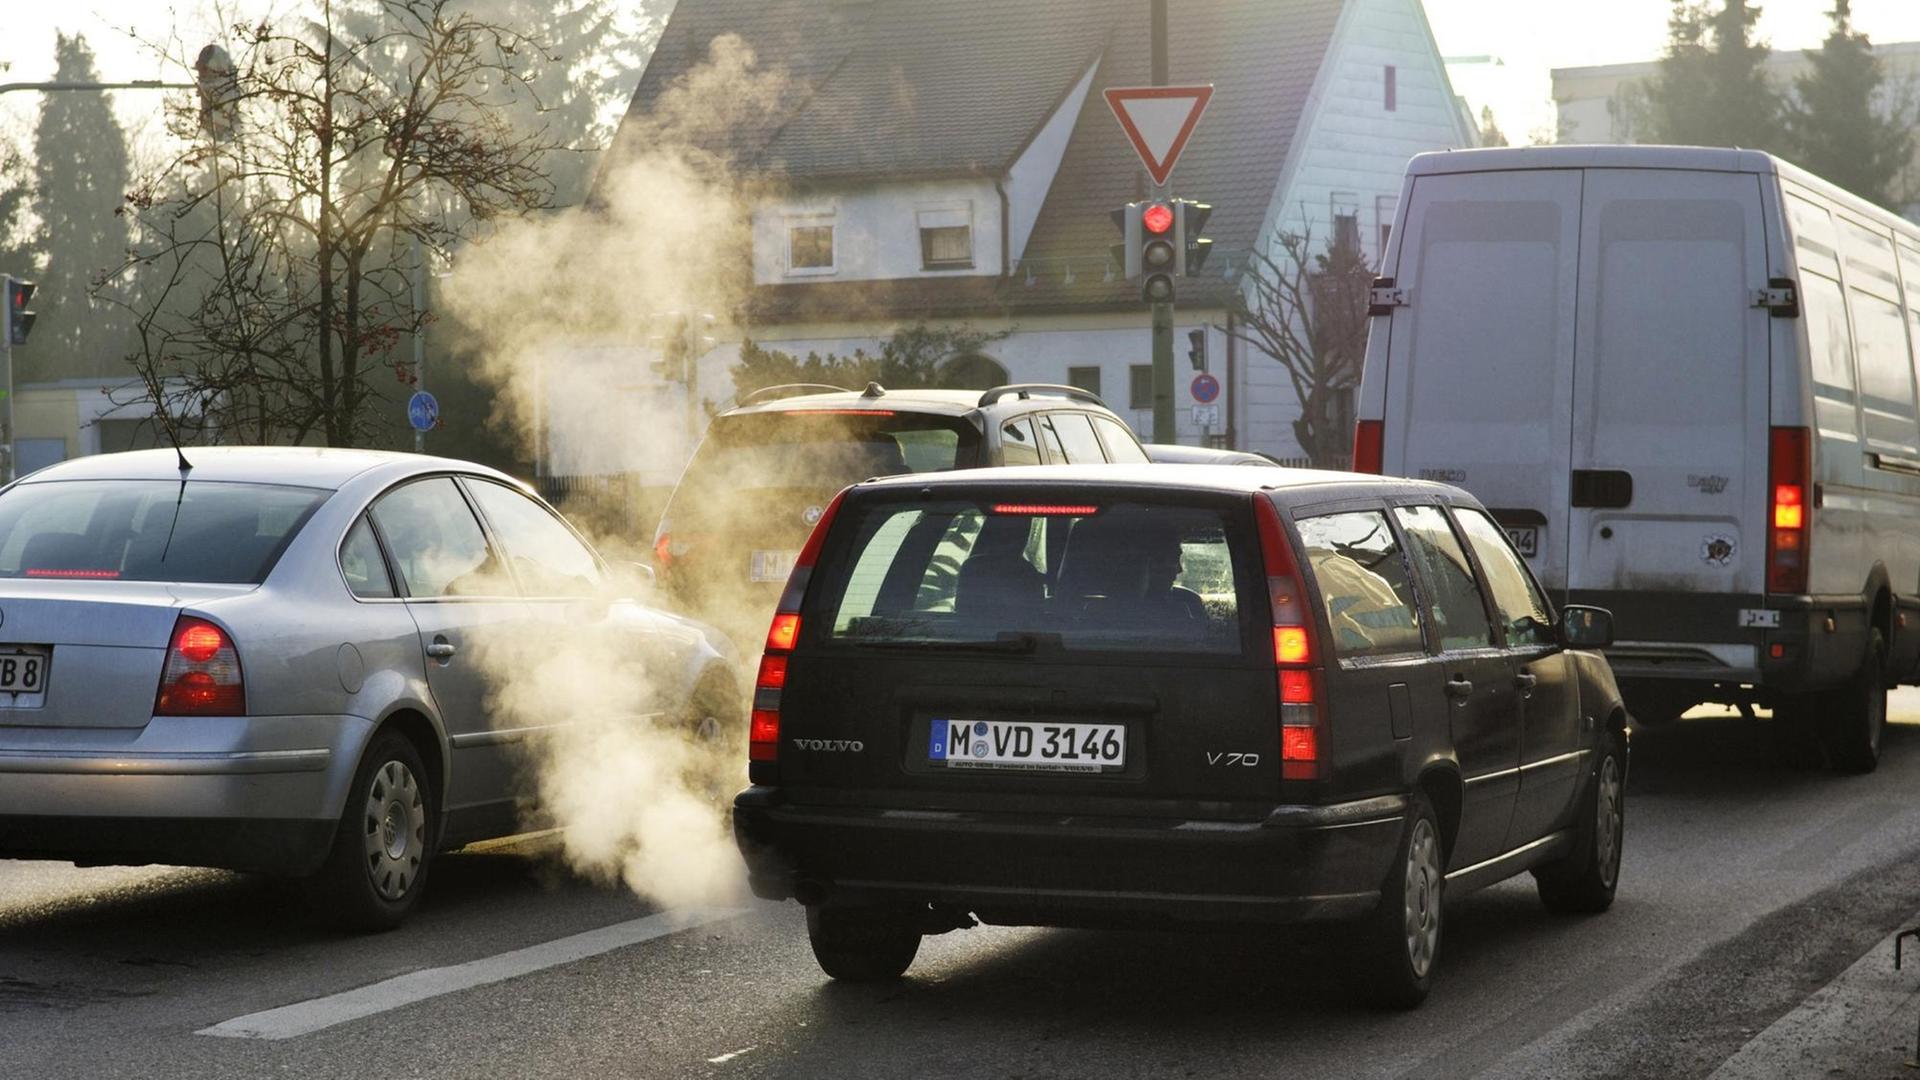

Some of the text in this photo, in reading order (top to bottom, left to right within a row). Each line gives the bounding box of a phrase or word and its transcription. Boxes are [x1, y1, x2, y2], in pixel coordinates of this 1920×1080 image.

[0, 658, 38, 688] B 8
[792, 738, 864, 752] VOLVO
[993, 725, 1034, 757] VD
[1041, 727, 1120, 760] 3146
